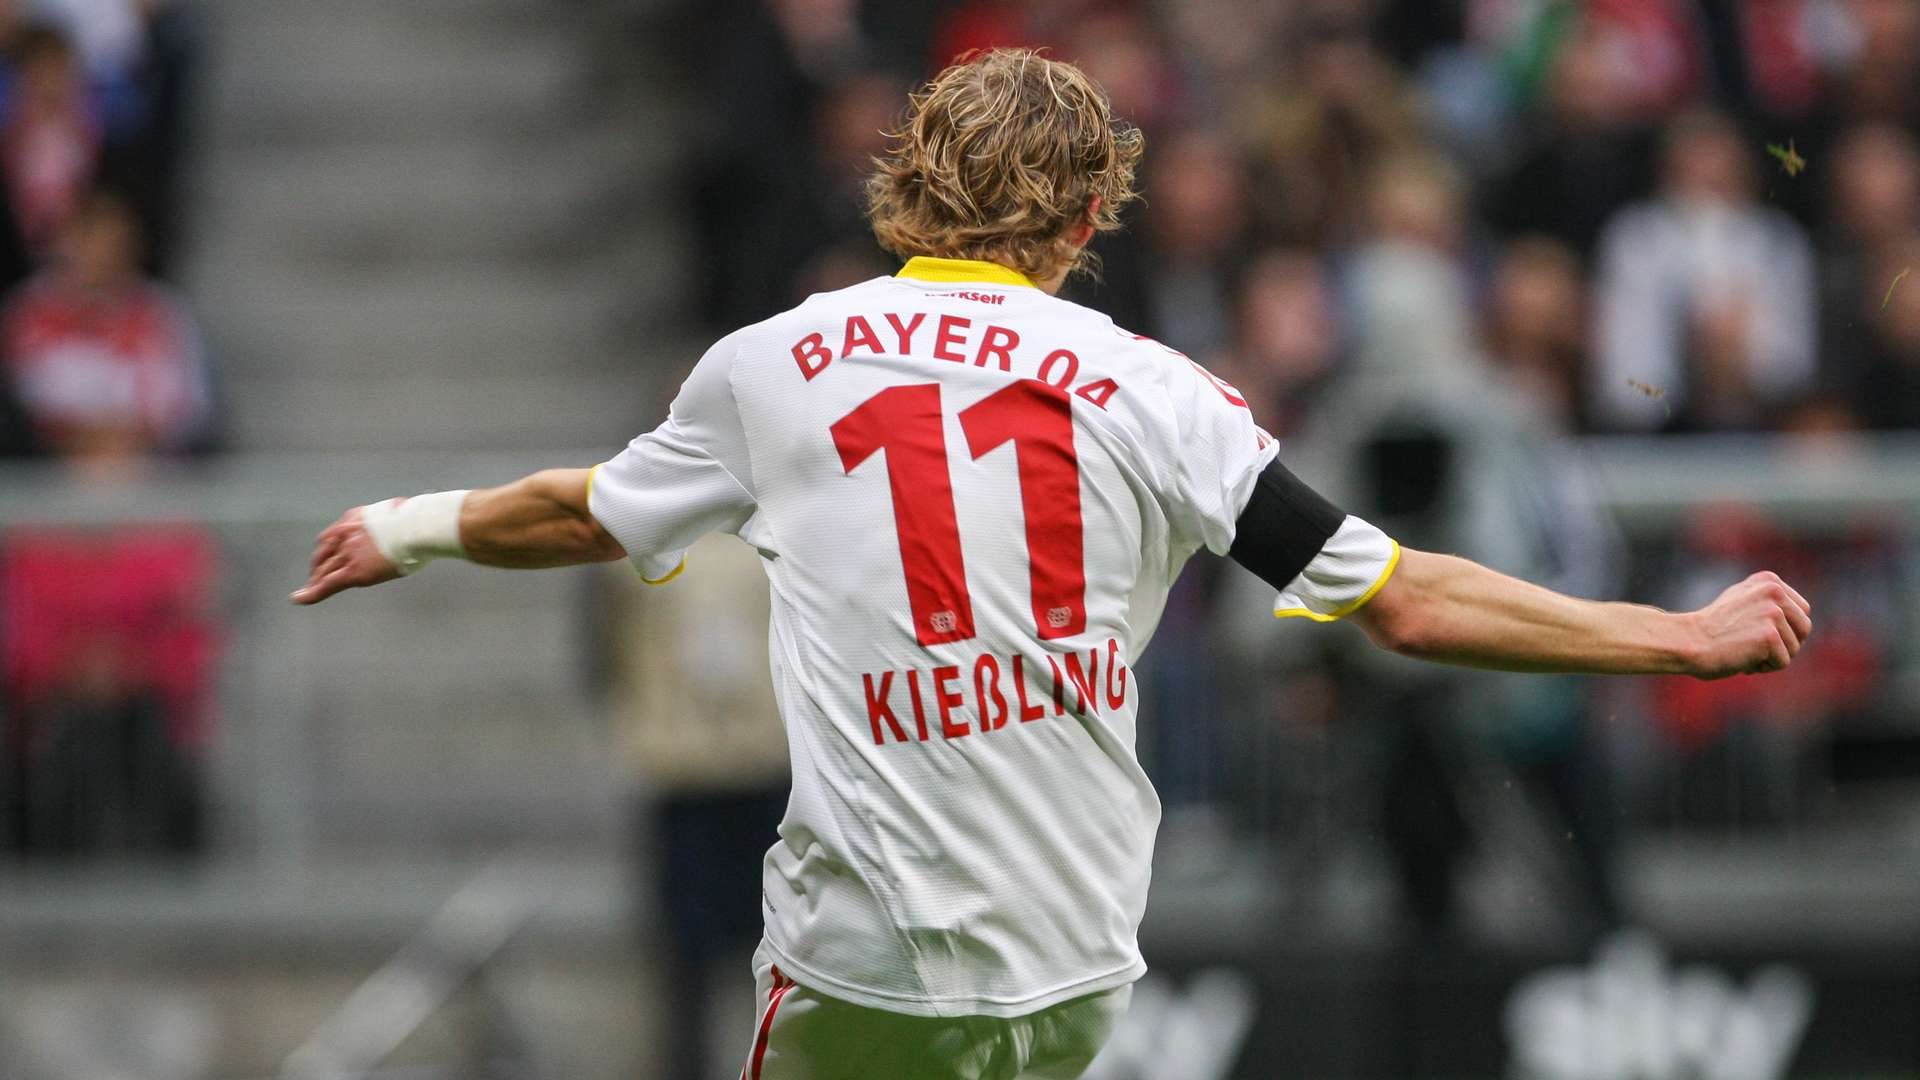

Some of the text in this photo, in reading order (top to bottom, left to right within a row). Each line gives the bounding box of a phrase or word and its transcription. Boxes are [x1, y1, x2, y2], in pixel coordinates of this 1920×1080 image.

[791, 312, 1120, 412] BAYER 04
[830, 379, 1087, 649] 11
[862, 638, 1127, 746] KIEßLING
